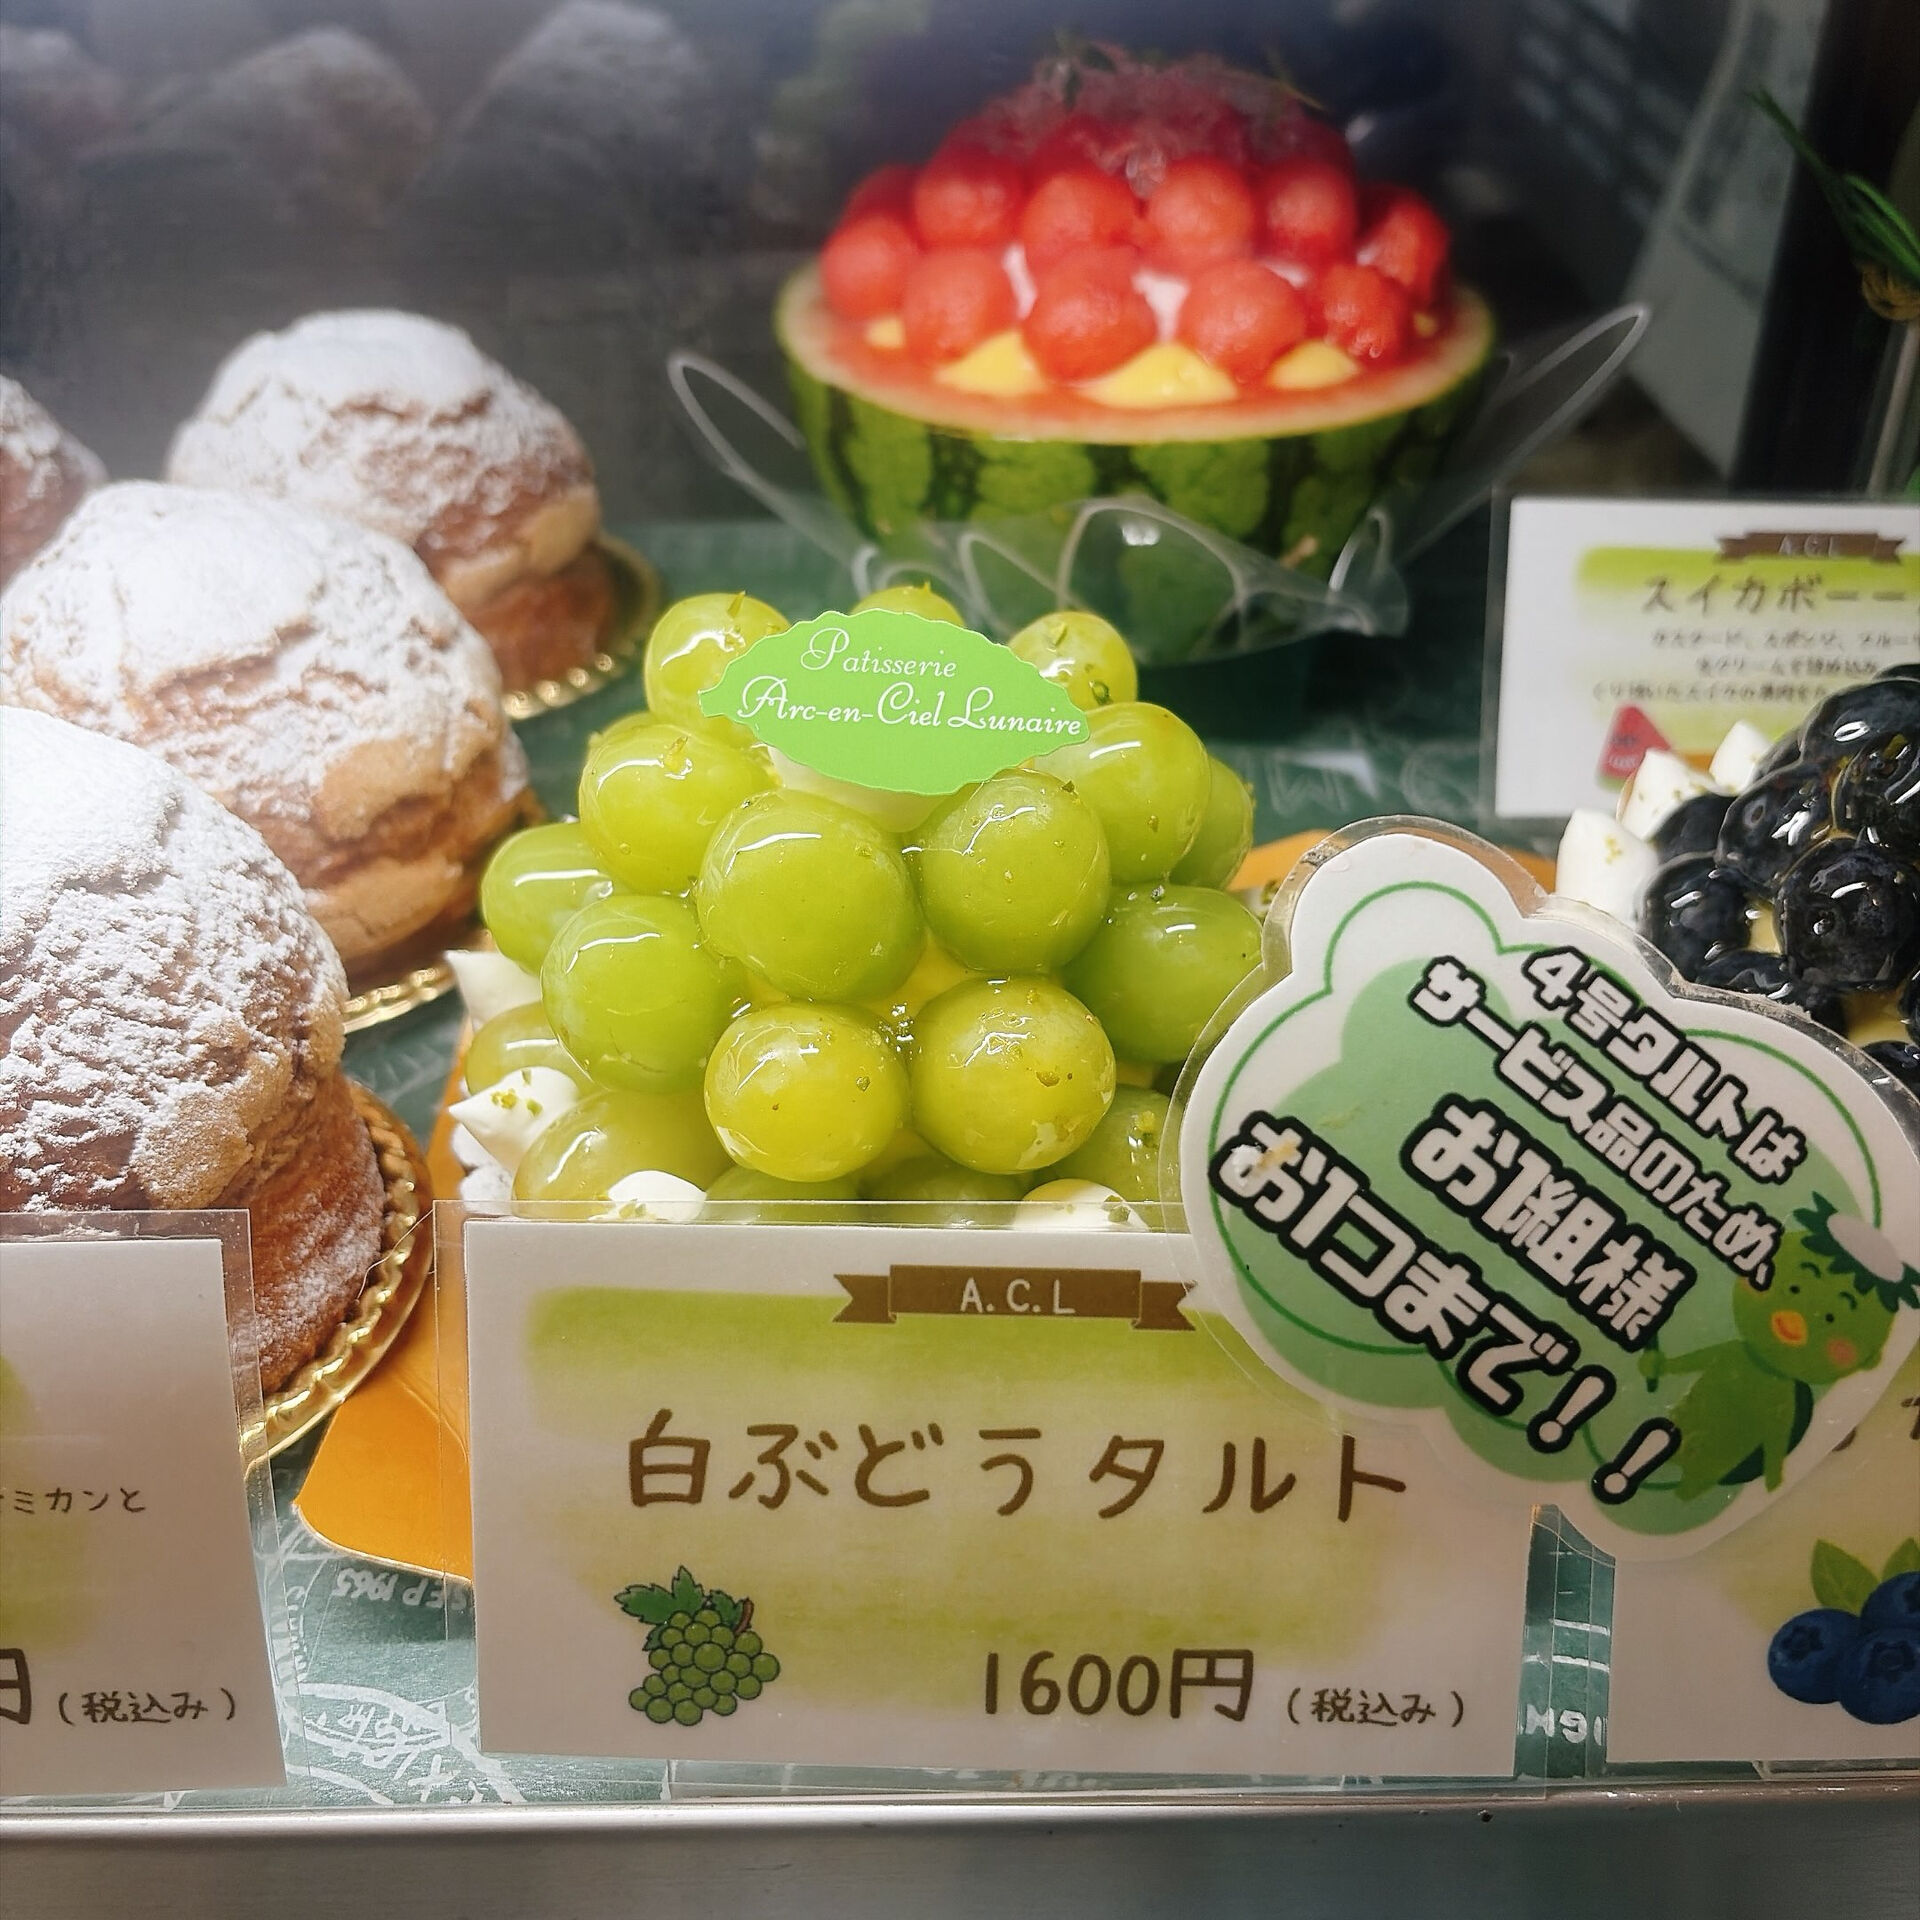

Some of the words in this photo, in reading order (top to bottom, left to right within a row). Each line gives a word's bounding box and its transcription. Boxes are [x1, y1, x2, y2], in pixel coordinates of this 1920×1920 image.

[1644, 574, 1920, 613] スイカボーー
[800, 627, 956, 678] Patisserie
[737, 675, 943, 728] Arc-en-Ciel
[947, 686, 1082, 736] Lunaire
[1523, 947, 1807, 1184] 4号タルトは
[1408, 956, 1781, 1291] サービス品のため、
[1400, 1094, 1697, 1352] お1組様
[960, 1278, 1076, 1316] A.C.L
[627, 1408, 1407, 1523] 白ぶどうタルト
[0, 1486, 147, 1515] ミカンと
[59, 1687, 236, 1726] （税込み）
[985, 1649, 1255, 1723] 1600円
[1287, 1688, 1466, 1727] （税込み）
